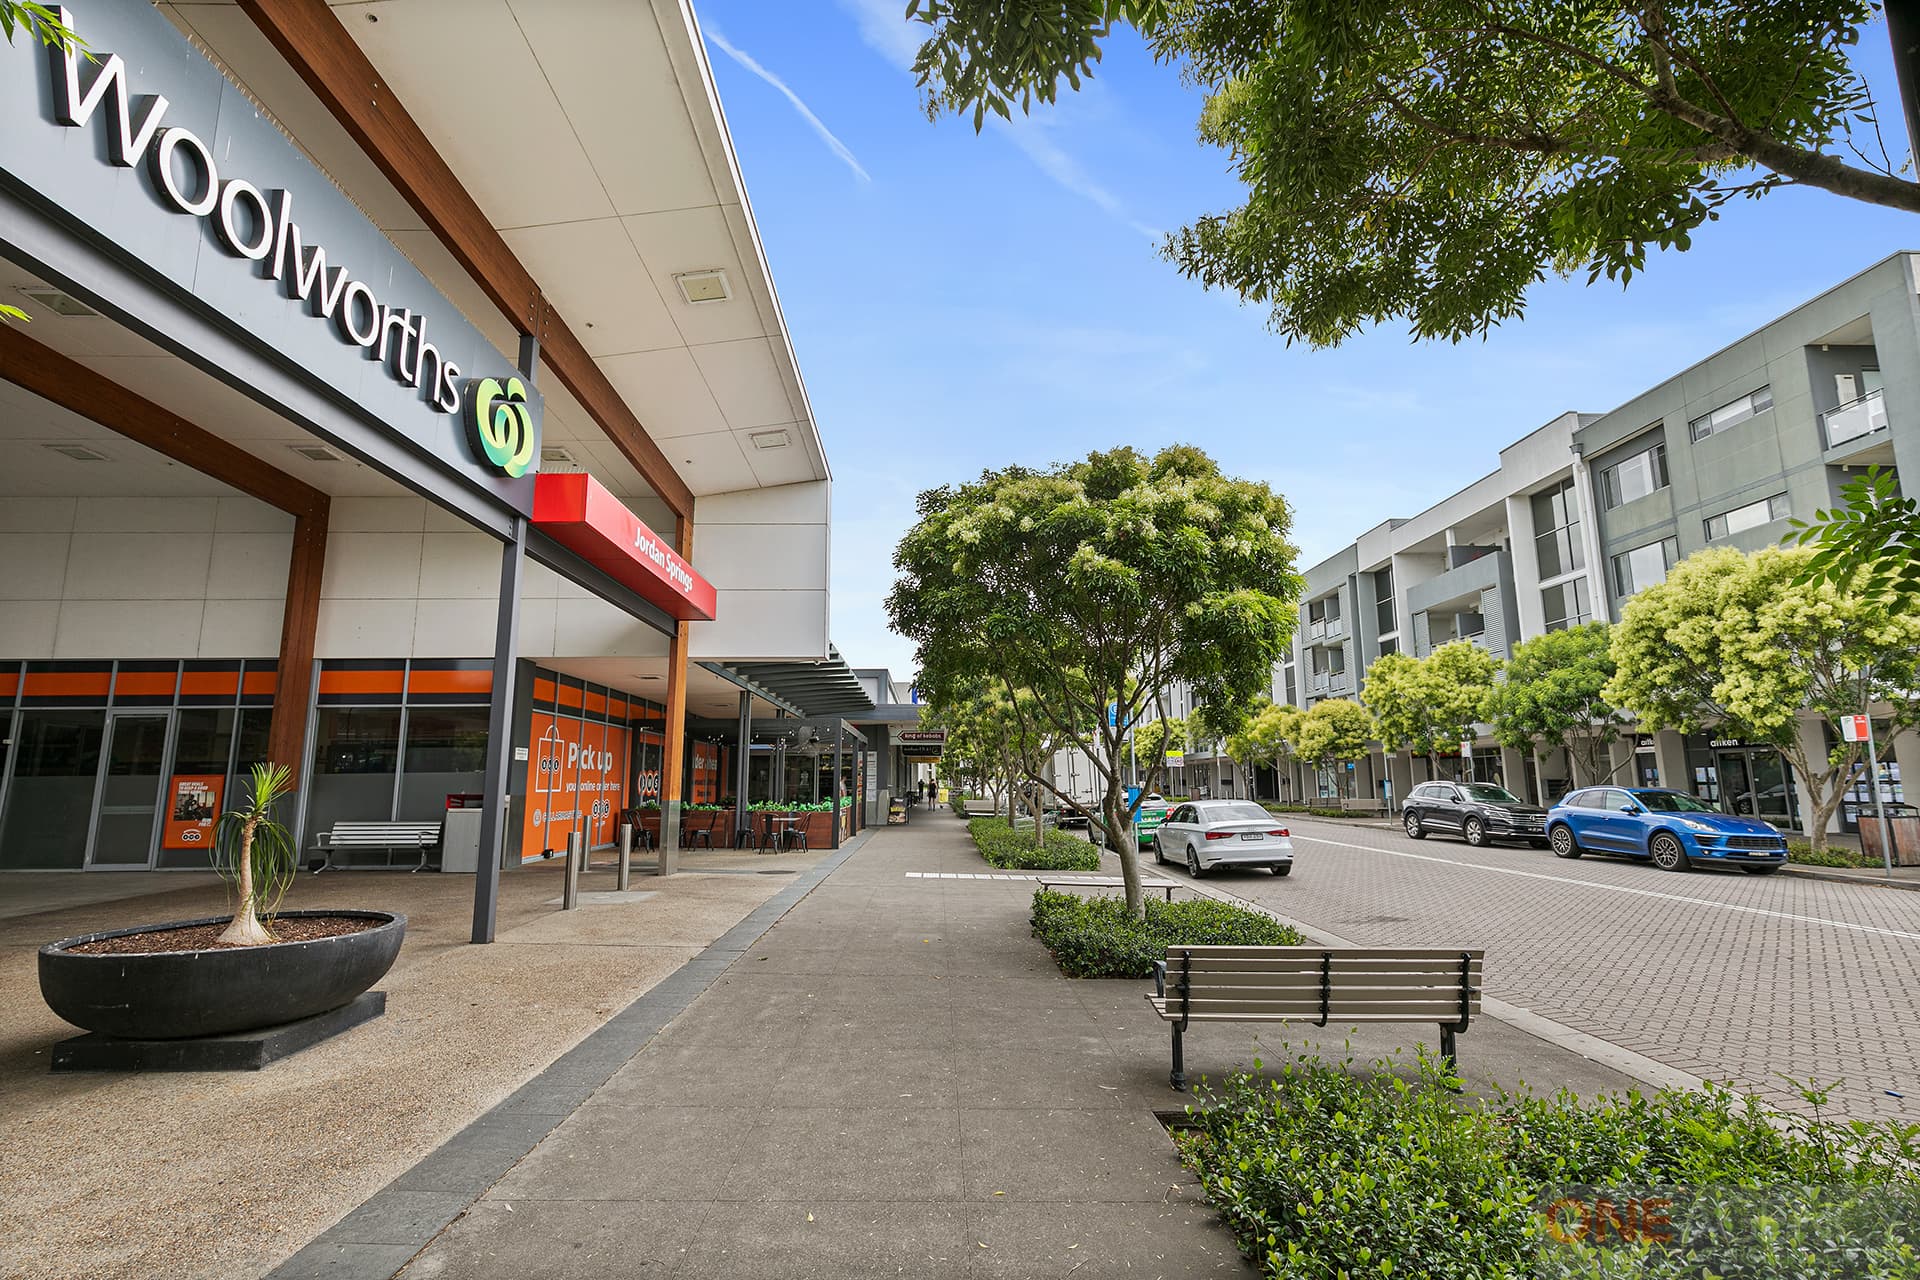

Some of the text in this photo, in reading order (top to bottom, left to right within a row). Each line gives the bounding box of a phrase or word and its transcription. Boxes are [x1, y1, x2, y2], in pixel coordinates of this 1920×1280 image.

[635, 527, 692, 592] Jordan Springs
[568, 743, 595, 770] Pick
[597, 752, 613, 774] up
[566, 782, 577, 793] you
